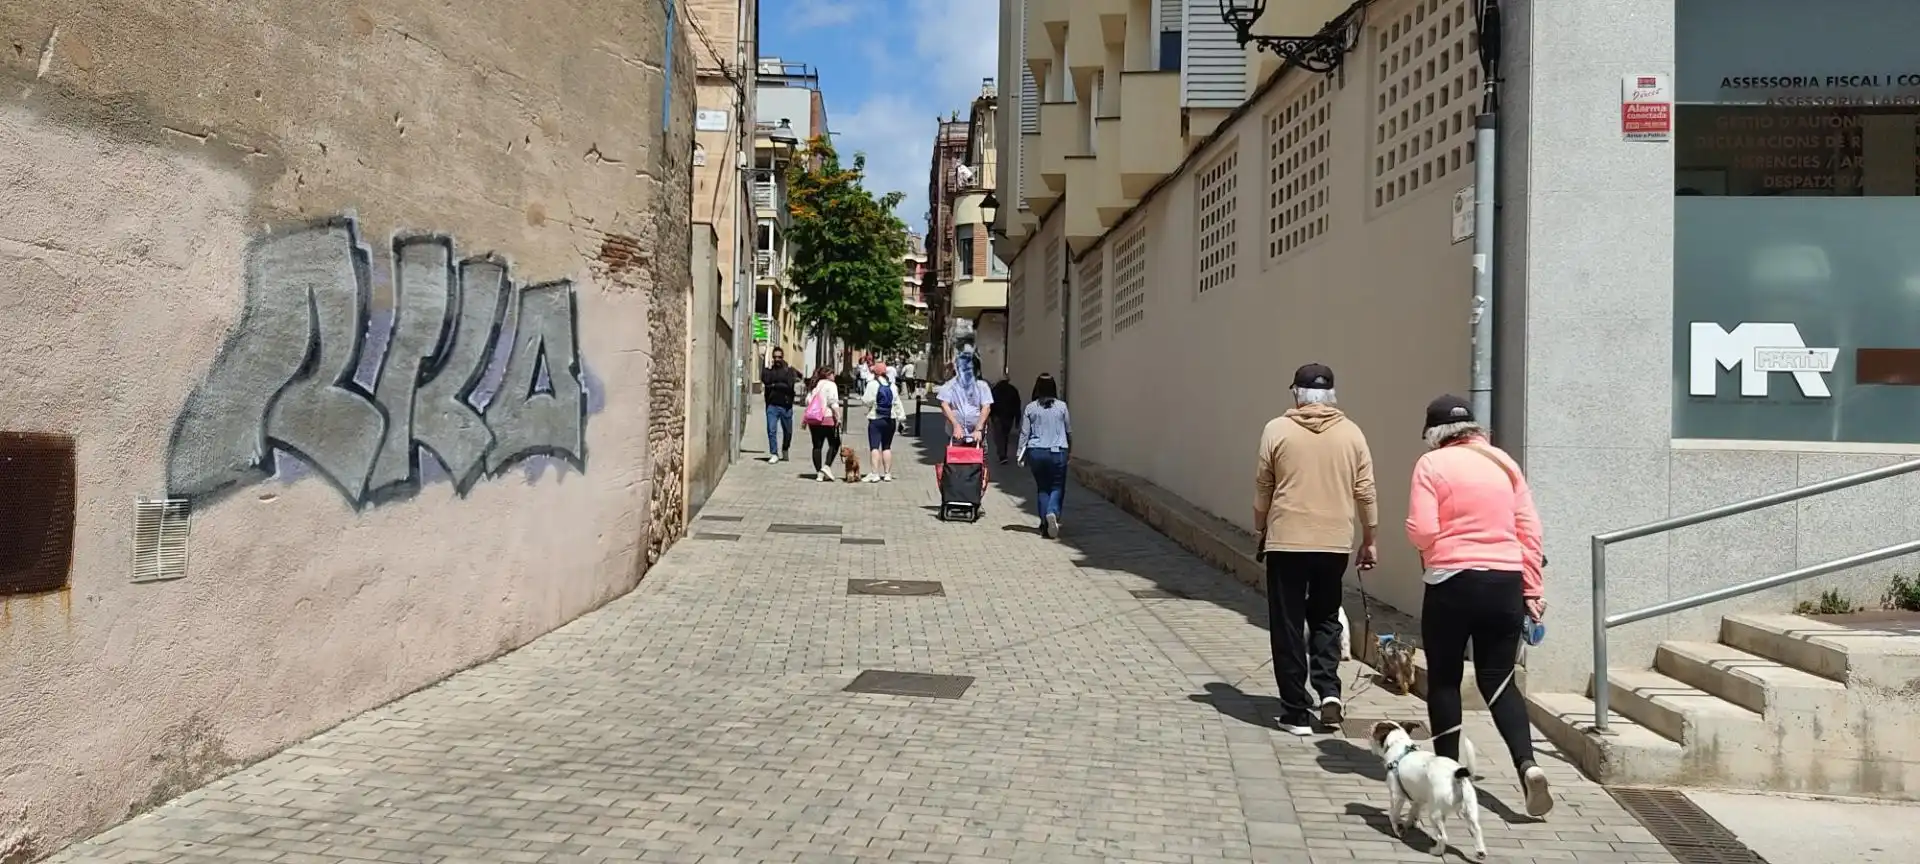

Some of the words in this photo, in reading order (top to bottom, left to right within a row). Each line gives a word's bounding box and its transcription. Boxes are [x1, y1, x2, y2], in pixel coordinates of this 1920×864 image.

[1720, 76, 1819, 89] ASSESSORIA
[1826, 75, 1881, 88] FISCAL
[1767, 95, 1863, 106] ASSESSORIA
[1871, 94, 1920, 105] LABO
[1627, 104, 1667, 113] Alarma
[1695, 136, 1819, 149] DECLARACIONS
[1825, 136, 1844, 148] DE
[1763, 175, 1834, 188] DESPATX
